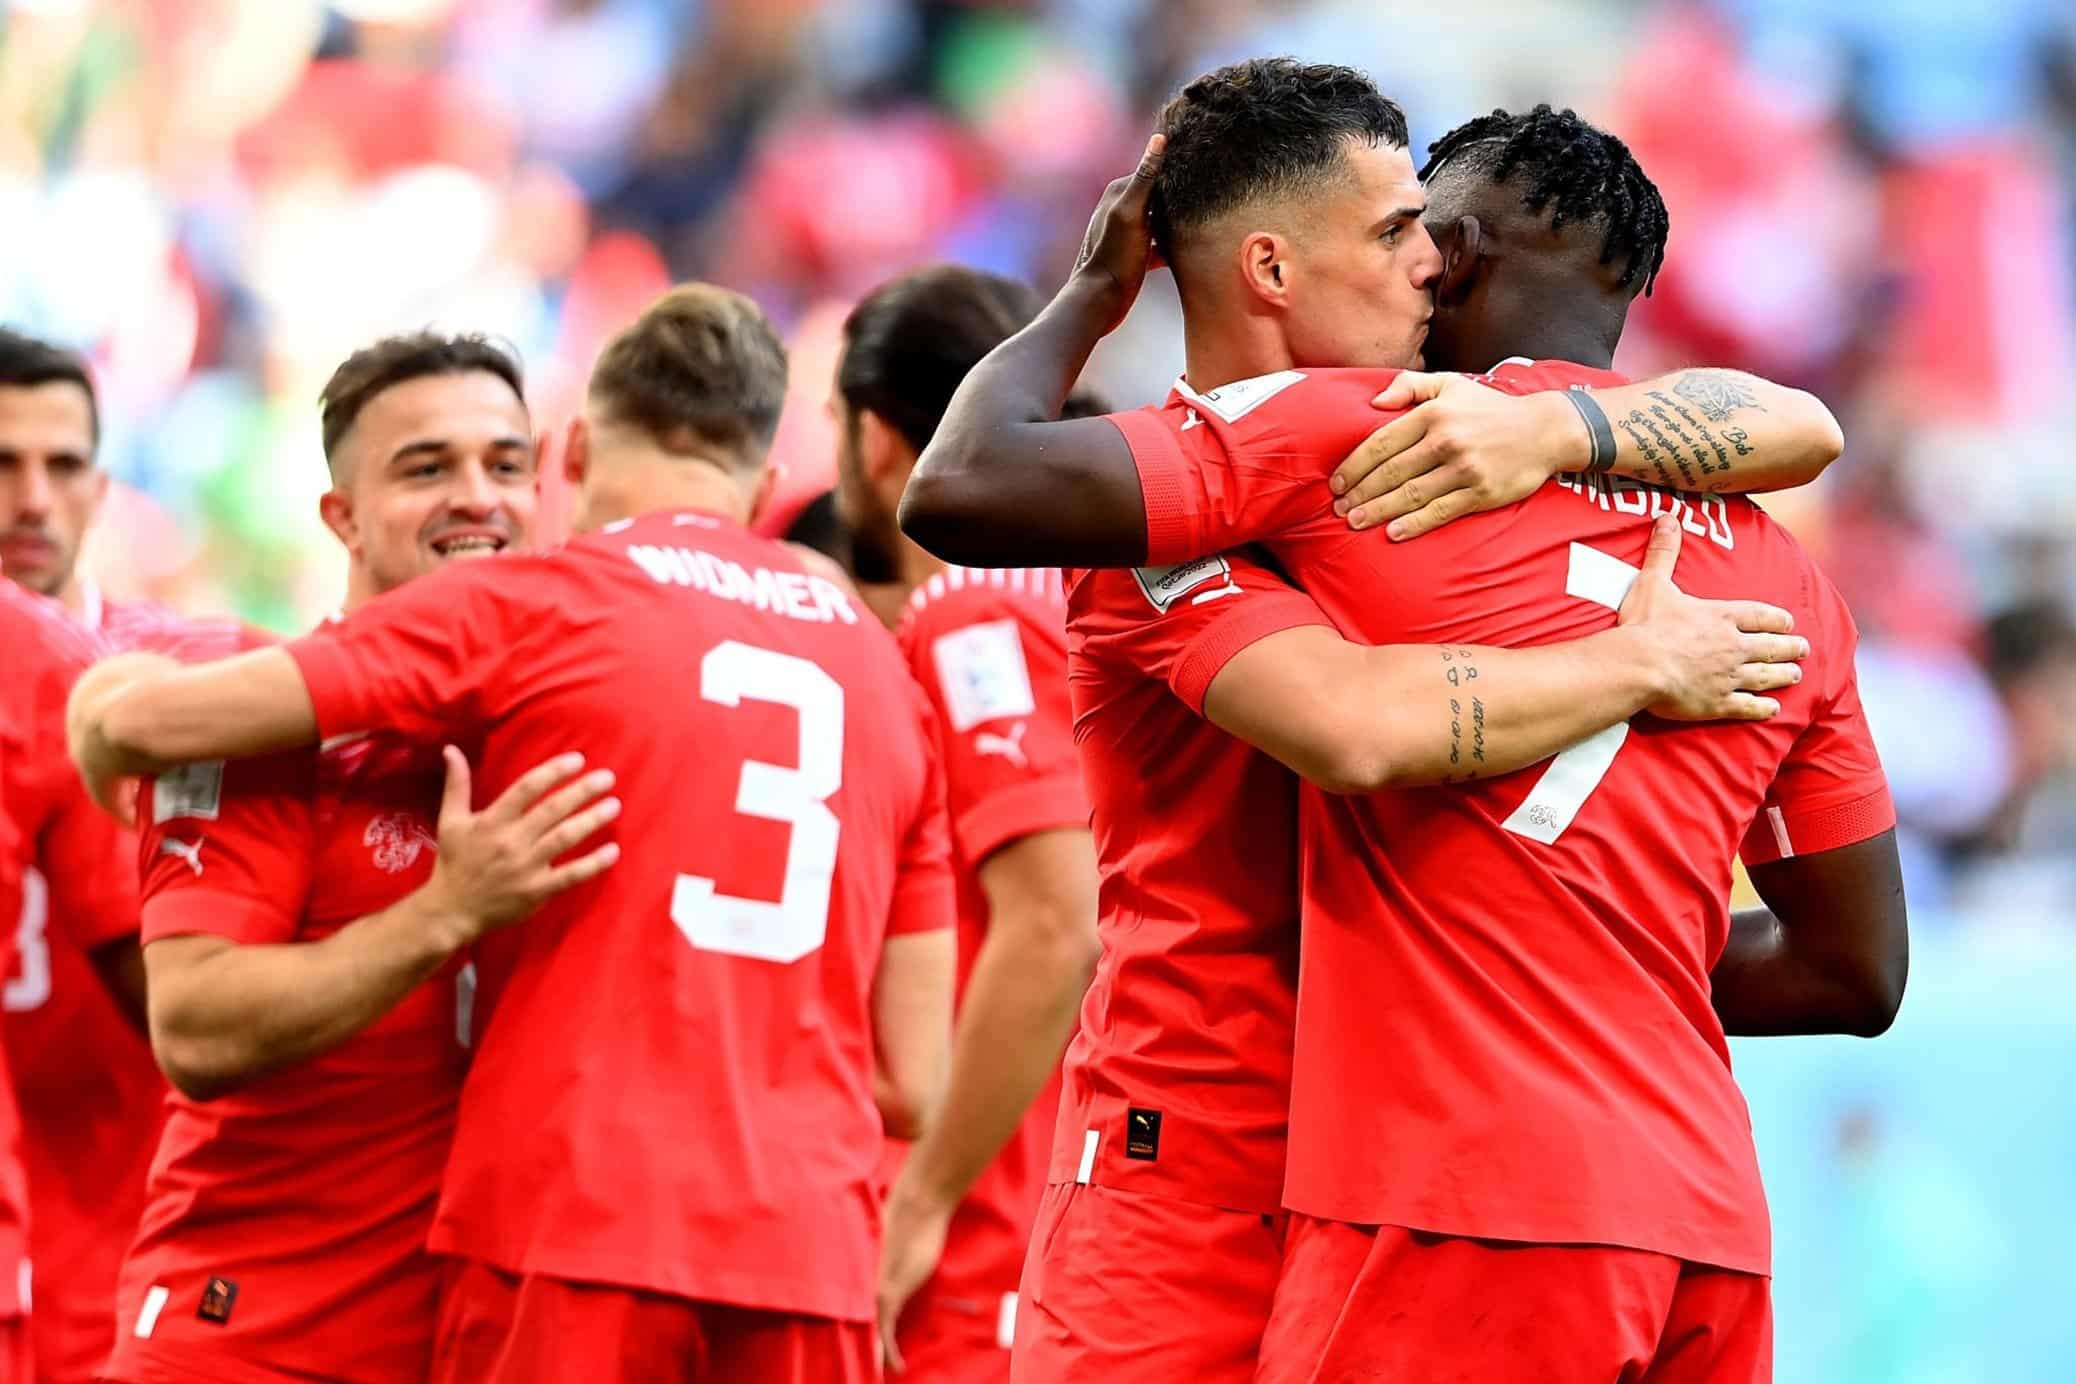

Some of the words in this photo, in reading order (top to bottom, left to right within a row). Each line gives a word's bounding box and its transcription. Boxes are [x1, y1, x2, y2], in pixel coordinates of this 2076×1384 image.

[1558, 473, 1734, 551] MBOLO
[627, 545, 858, 624] WIDMER
[670, 640, 844, 964] 3
